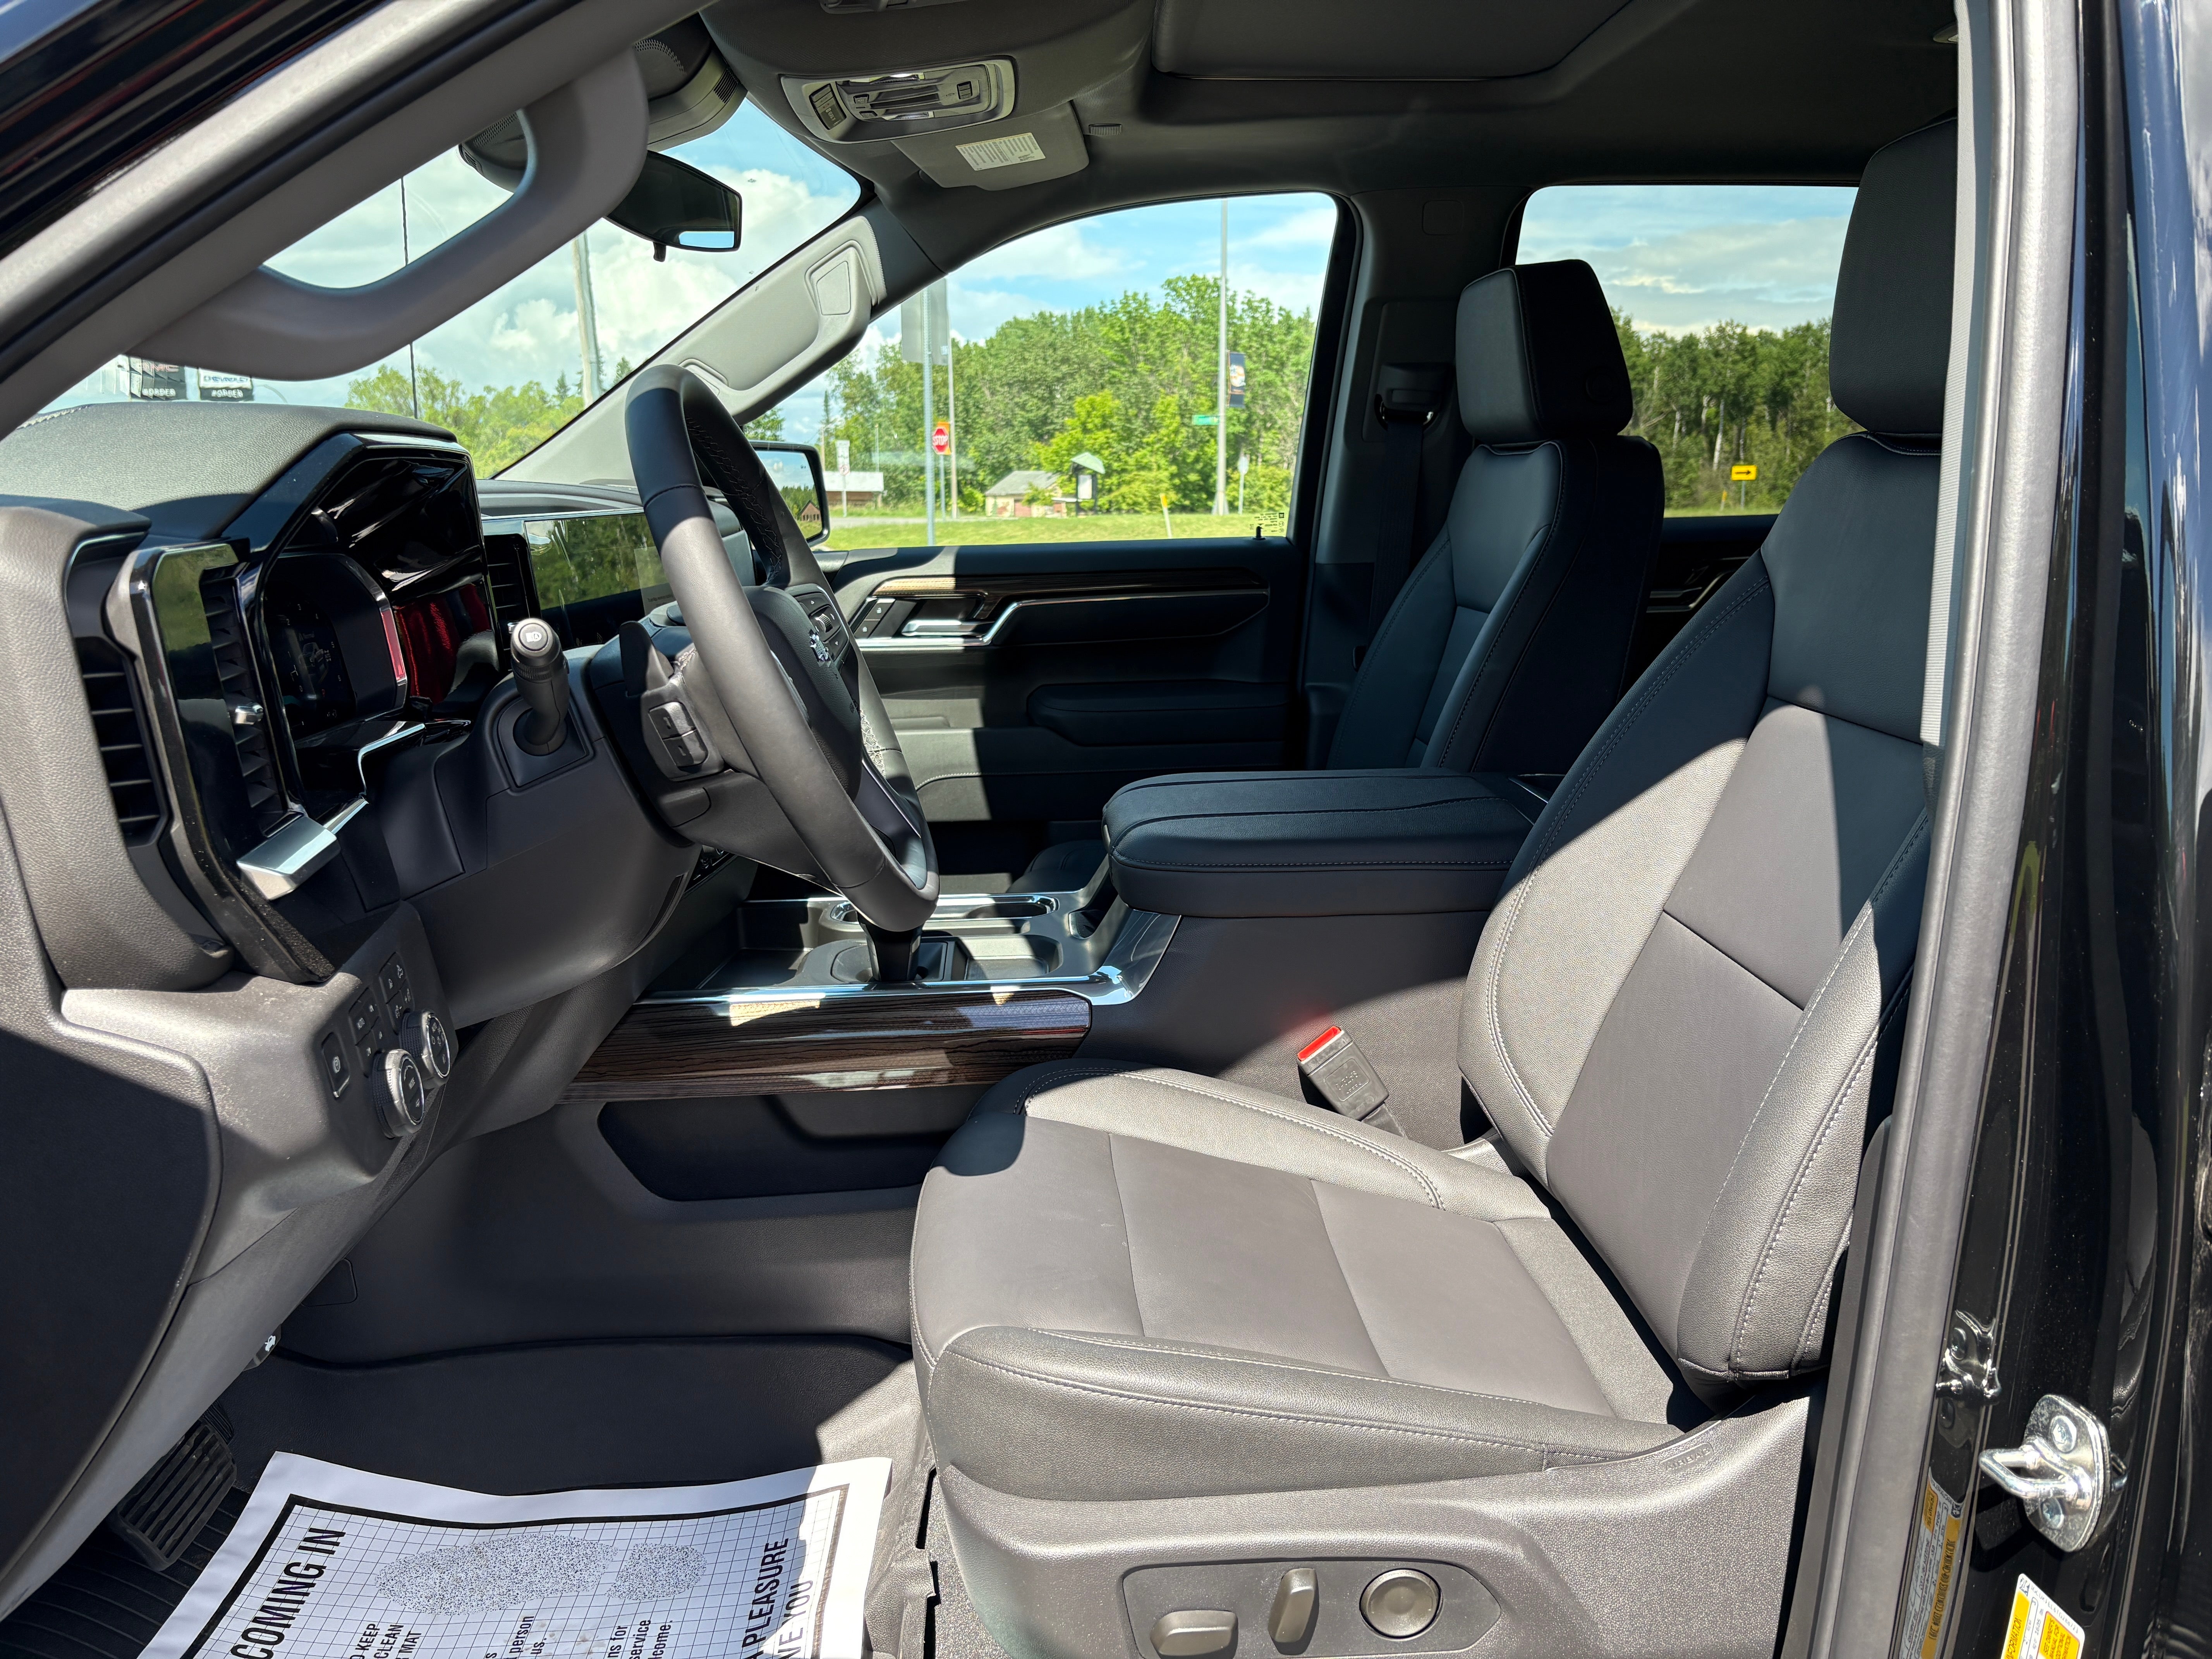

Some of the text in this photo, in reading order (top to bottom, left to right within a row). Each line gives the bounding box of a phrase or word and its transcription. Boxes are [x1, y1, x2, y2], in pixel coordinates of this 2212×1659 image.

[933, 435, 948, 446] STOP
[230, 1528, 346, 1659] COMING IN
[742, 1538, 788, 1648] PLEASURE
[781, 1580, 813, 1626] YOU
[355, 1623, 380, 1650] KEEP
[374, 1624, 404, 1659] CLEAN
[398, 1631, 422, 1653] MAT
[509, 1616, 534, 1654] person
[531, 1638, 547, 1654] us.
[610, 1626, 628, 1641] for
